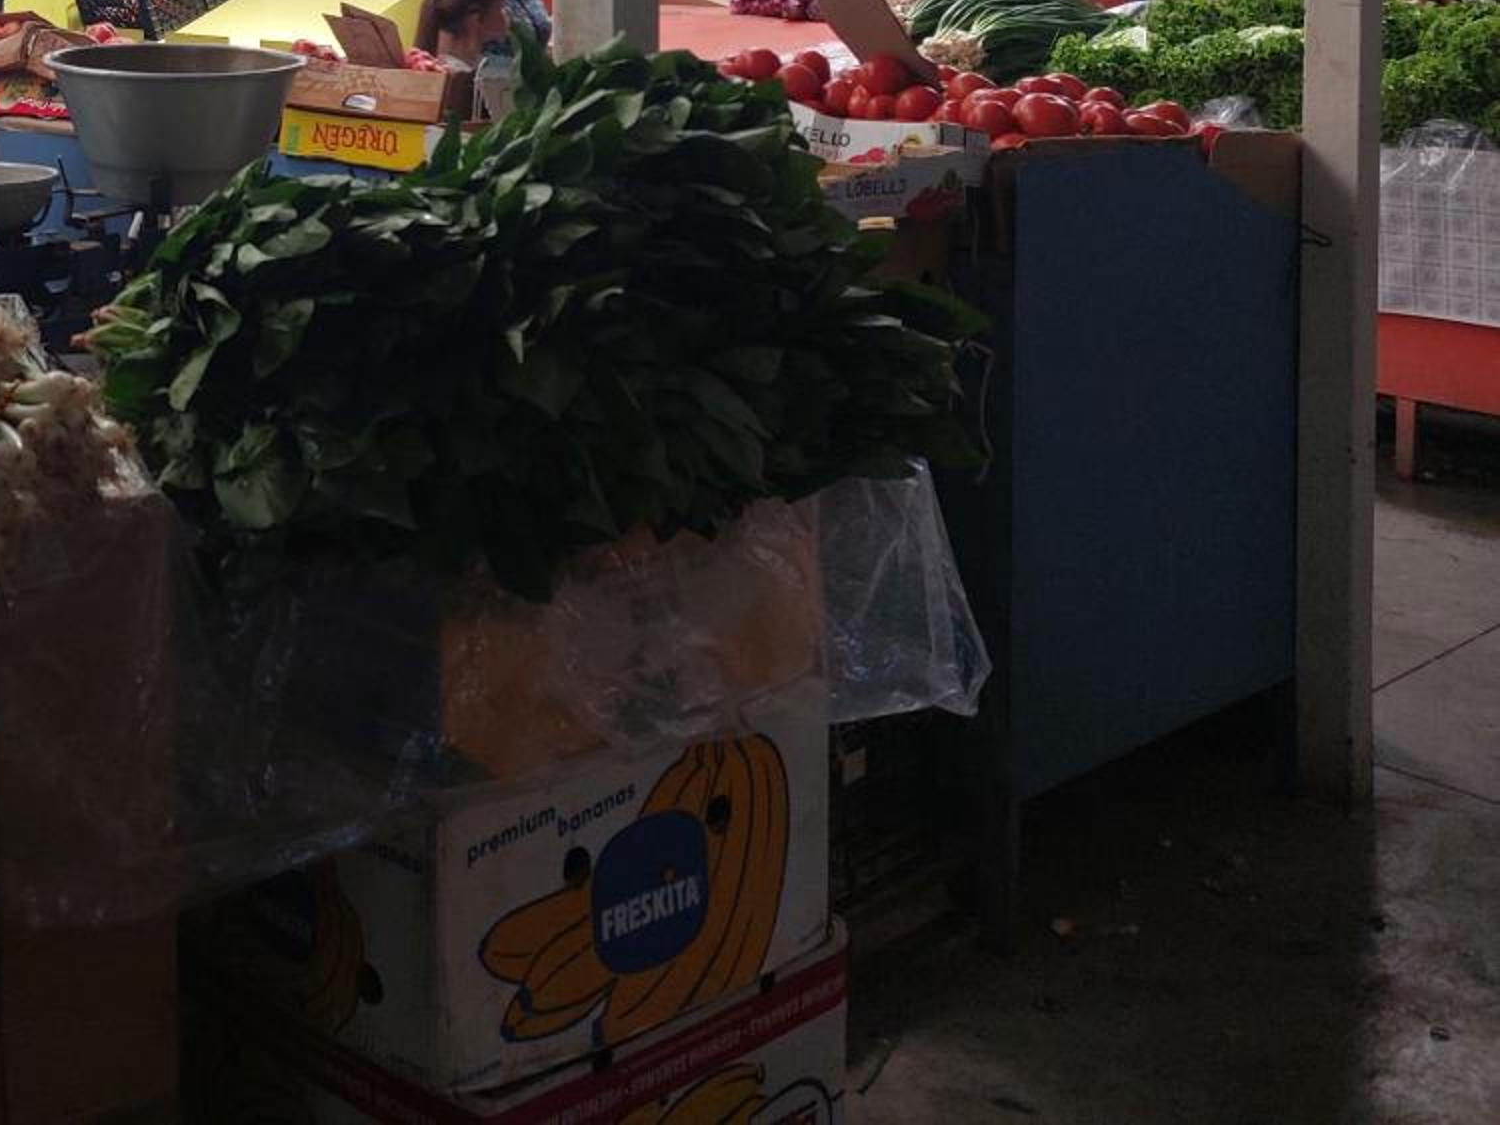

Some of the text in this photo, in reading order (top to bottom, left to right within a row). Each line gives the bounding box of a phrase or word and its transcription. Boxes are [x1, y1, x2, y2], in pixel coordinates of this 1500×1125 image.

[467, 805, 556, 867] premium
[556, 782, 637, 838] bananas
[600, 869, 700, 943] FRESKITA
